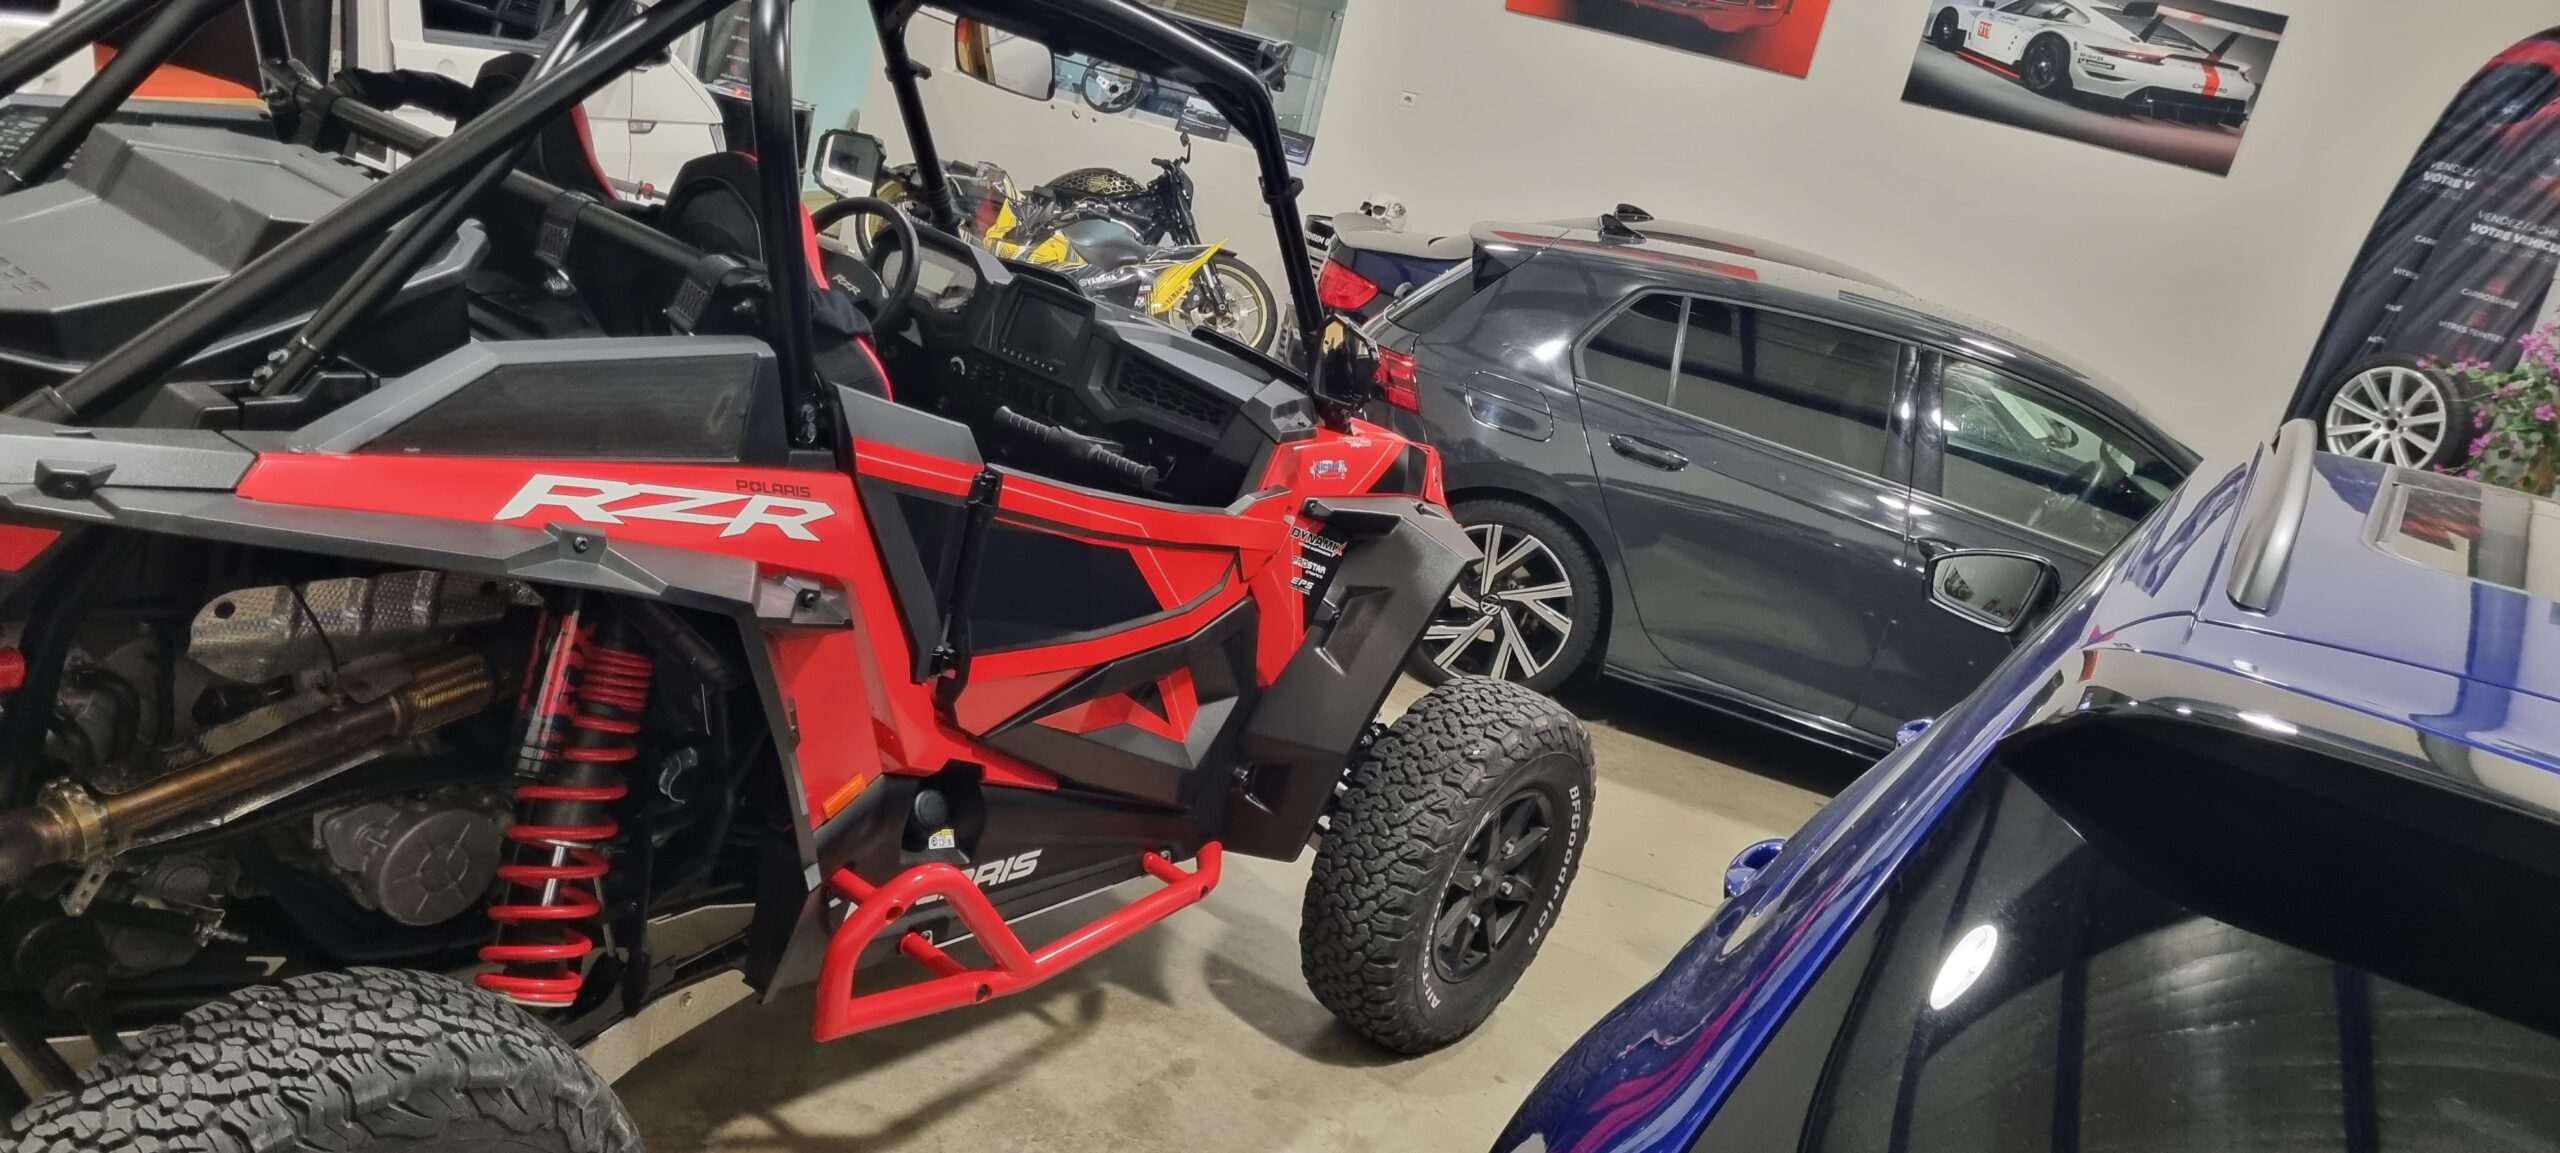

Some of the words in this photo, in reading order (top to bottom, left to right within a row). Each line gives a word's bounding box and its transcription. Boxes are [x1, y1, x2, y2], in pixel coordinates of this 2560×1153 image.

[1978, 21, 1992, 39] 911
[2430, 160, 2473, 177] VENDZ
[2423, 170, 2462, 189] VOTRE
[2470, 222, 2512, 241] VOTRE
[832, 273, 861, 297] RZR
[1086, 273, 1118, 286] YAMAHA
[1165, 285, 1186, 306] YAMAHA
[735, 478, 811, 498] POLARIS
[492, 473, 837, 542] RZR
[1289, 526, 1348, 558] DYNAMIX
[1292, 555, 1326, 575] PROSTAR
[1290, 576, 1315, 590] EPS
[1527, 784, 1581, 946] BFGoodrich
